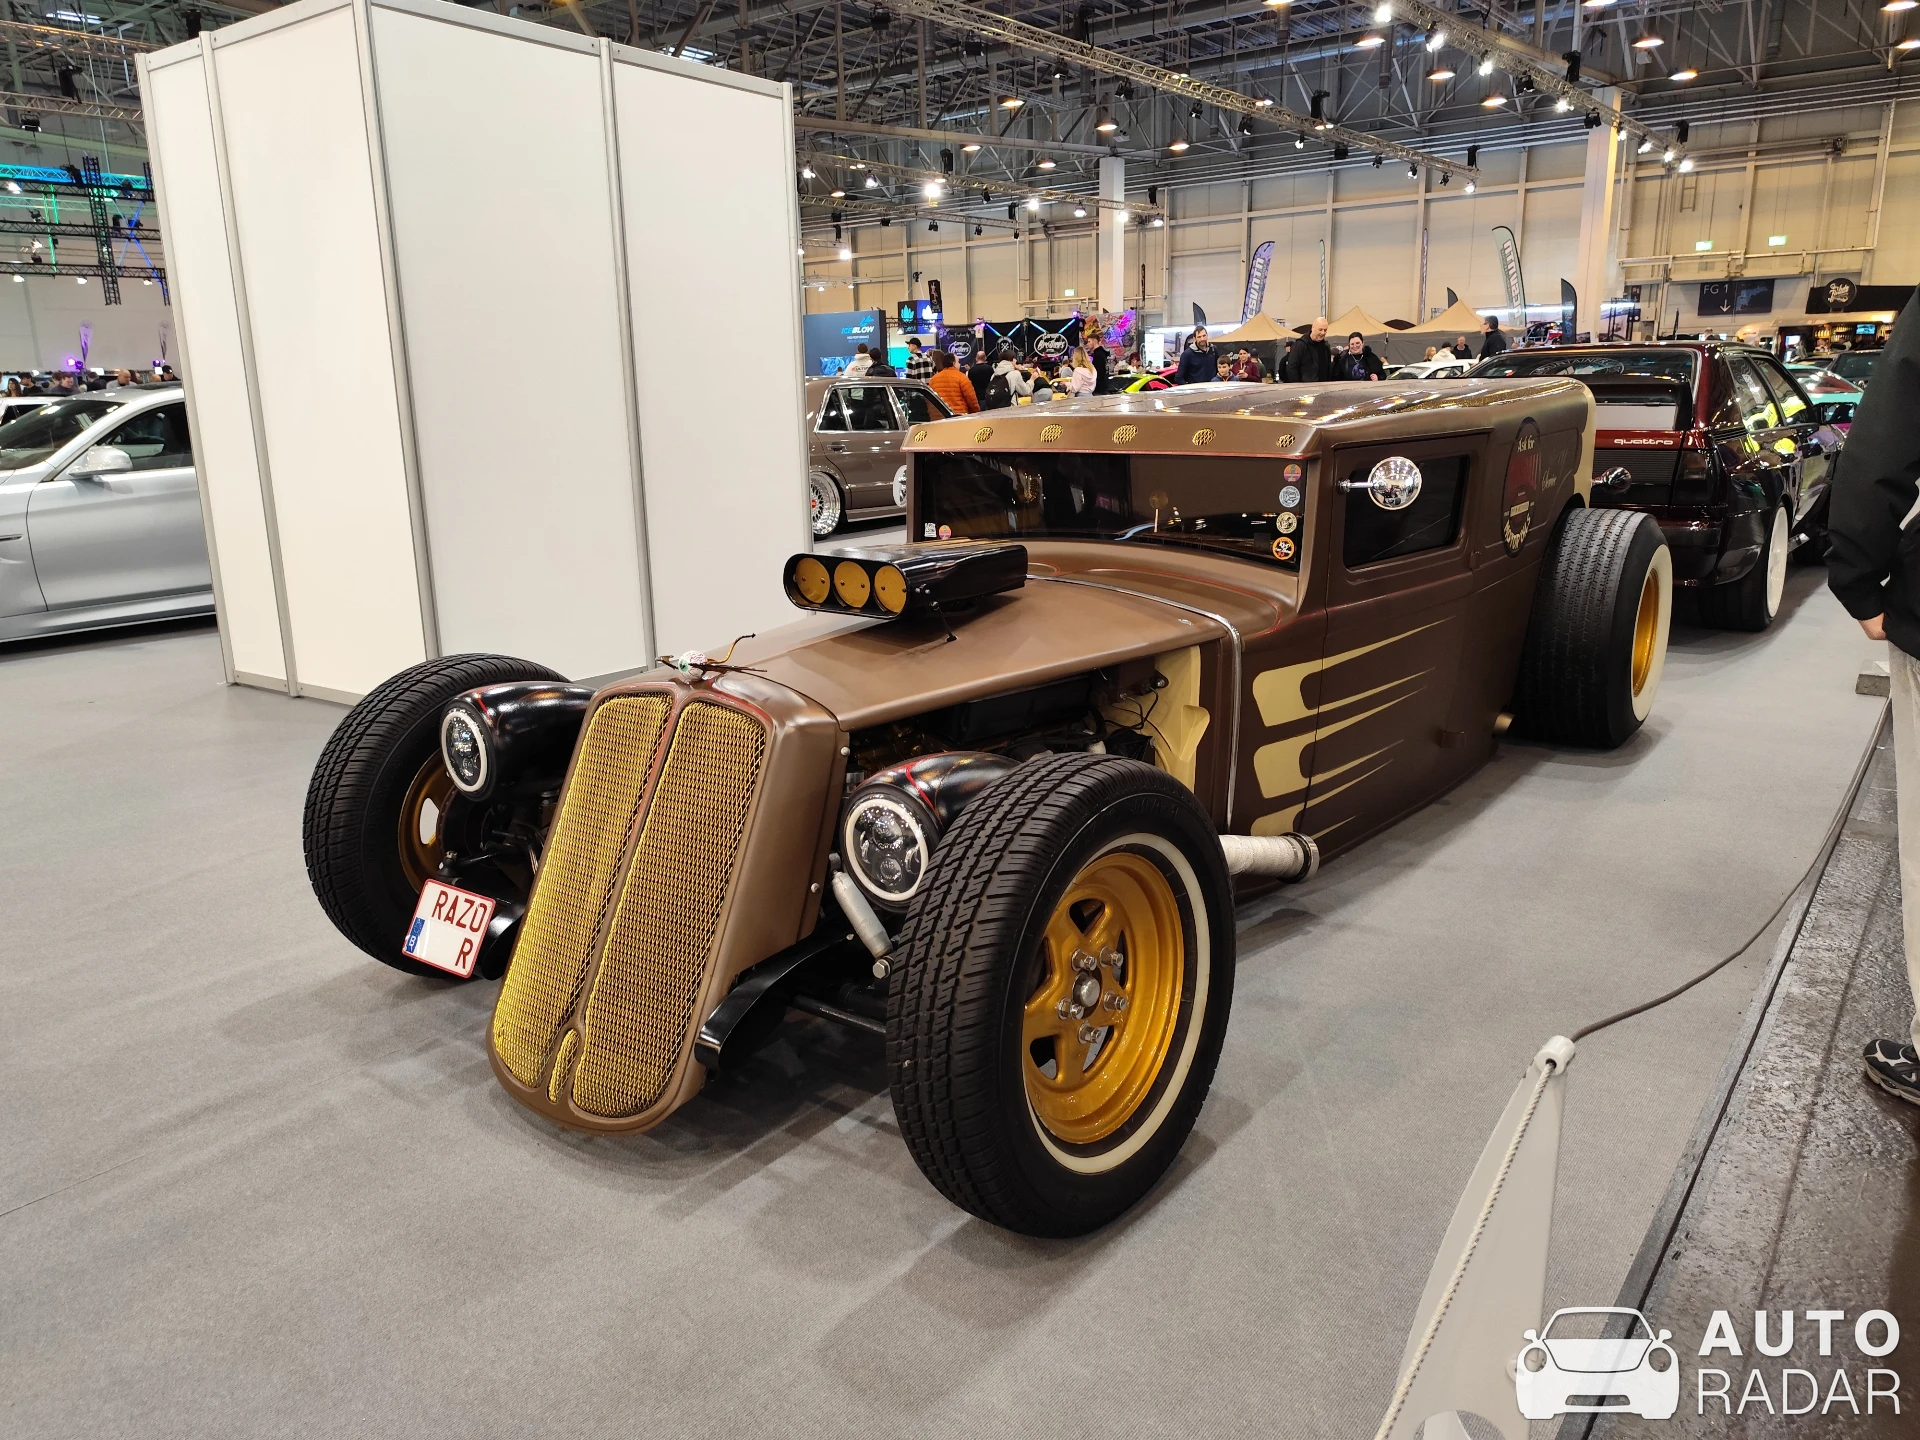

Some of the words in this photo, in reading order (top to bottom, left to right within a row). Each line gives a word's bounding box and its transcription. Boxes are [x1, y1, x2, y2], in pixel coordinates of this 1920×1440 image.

[1703, 284, 1719, 295] FG
[1723, 284, 1729, 294] 1
[841, 325, 874, 335] ICEBLOW
[1613, 438, 1674, 446] quattro
[431, 889, 488, 933] RAZO
[408, 935, 416, 947] B
[455, 937, 474, 970] R
